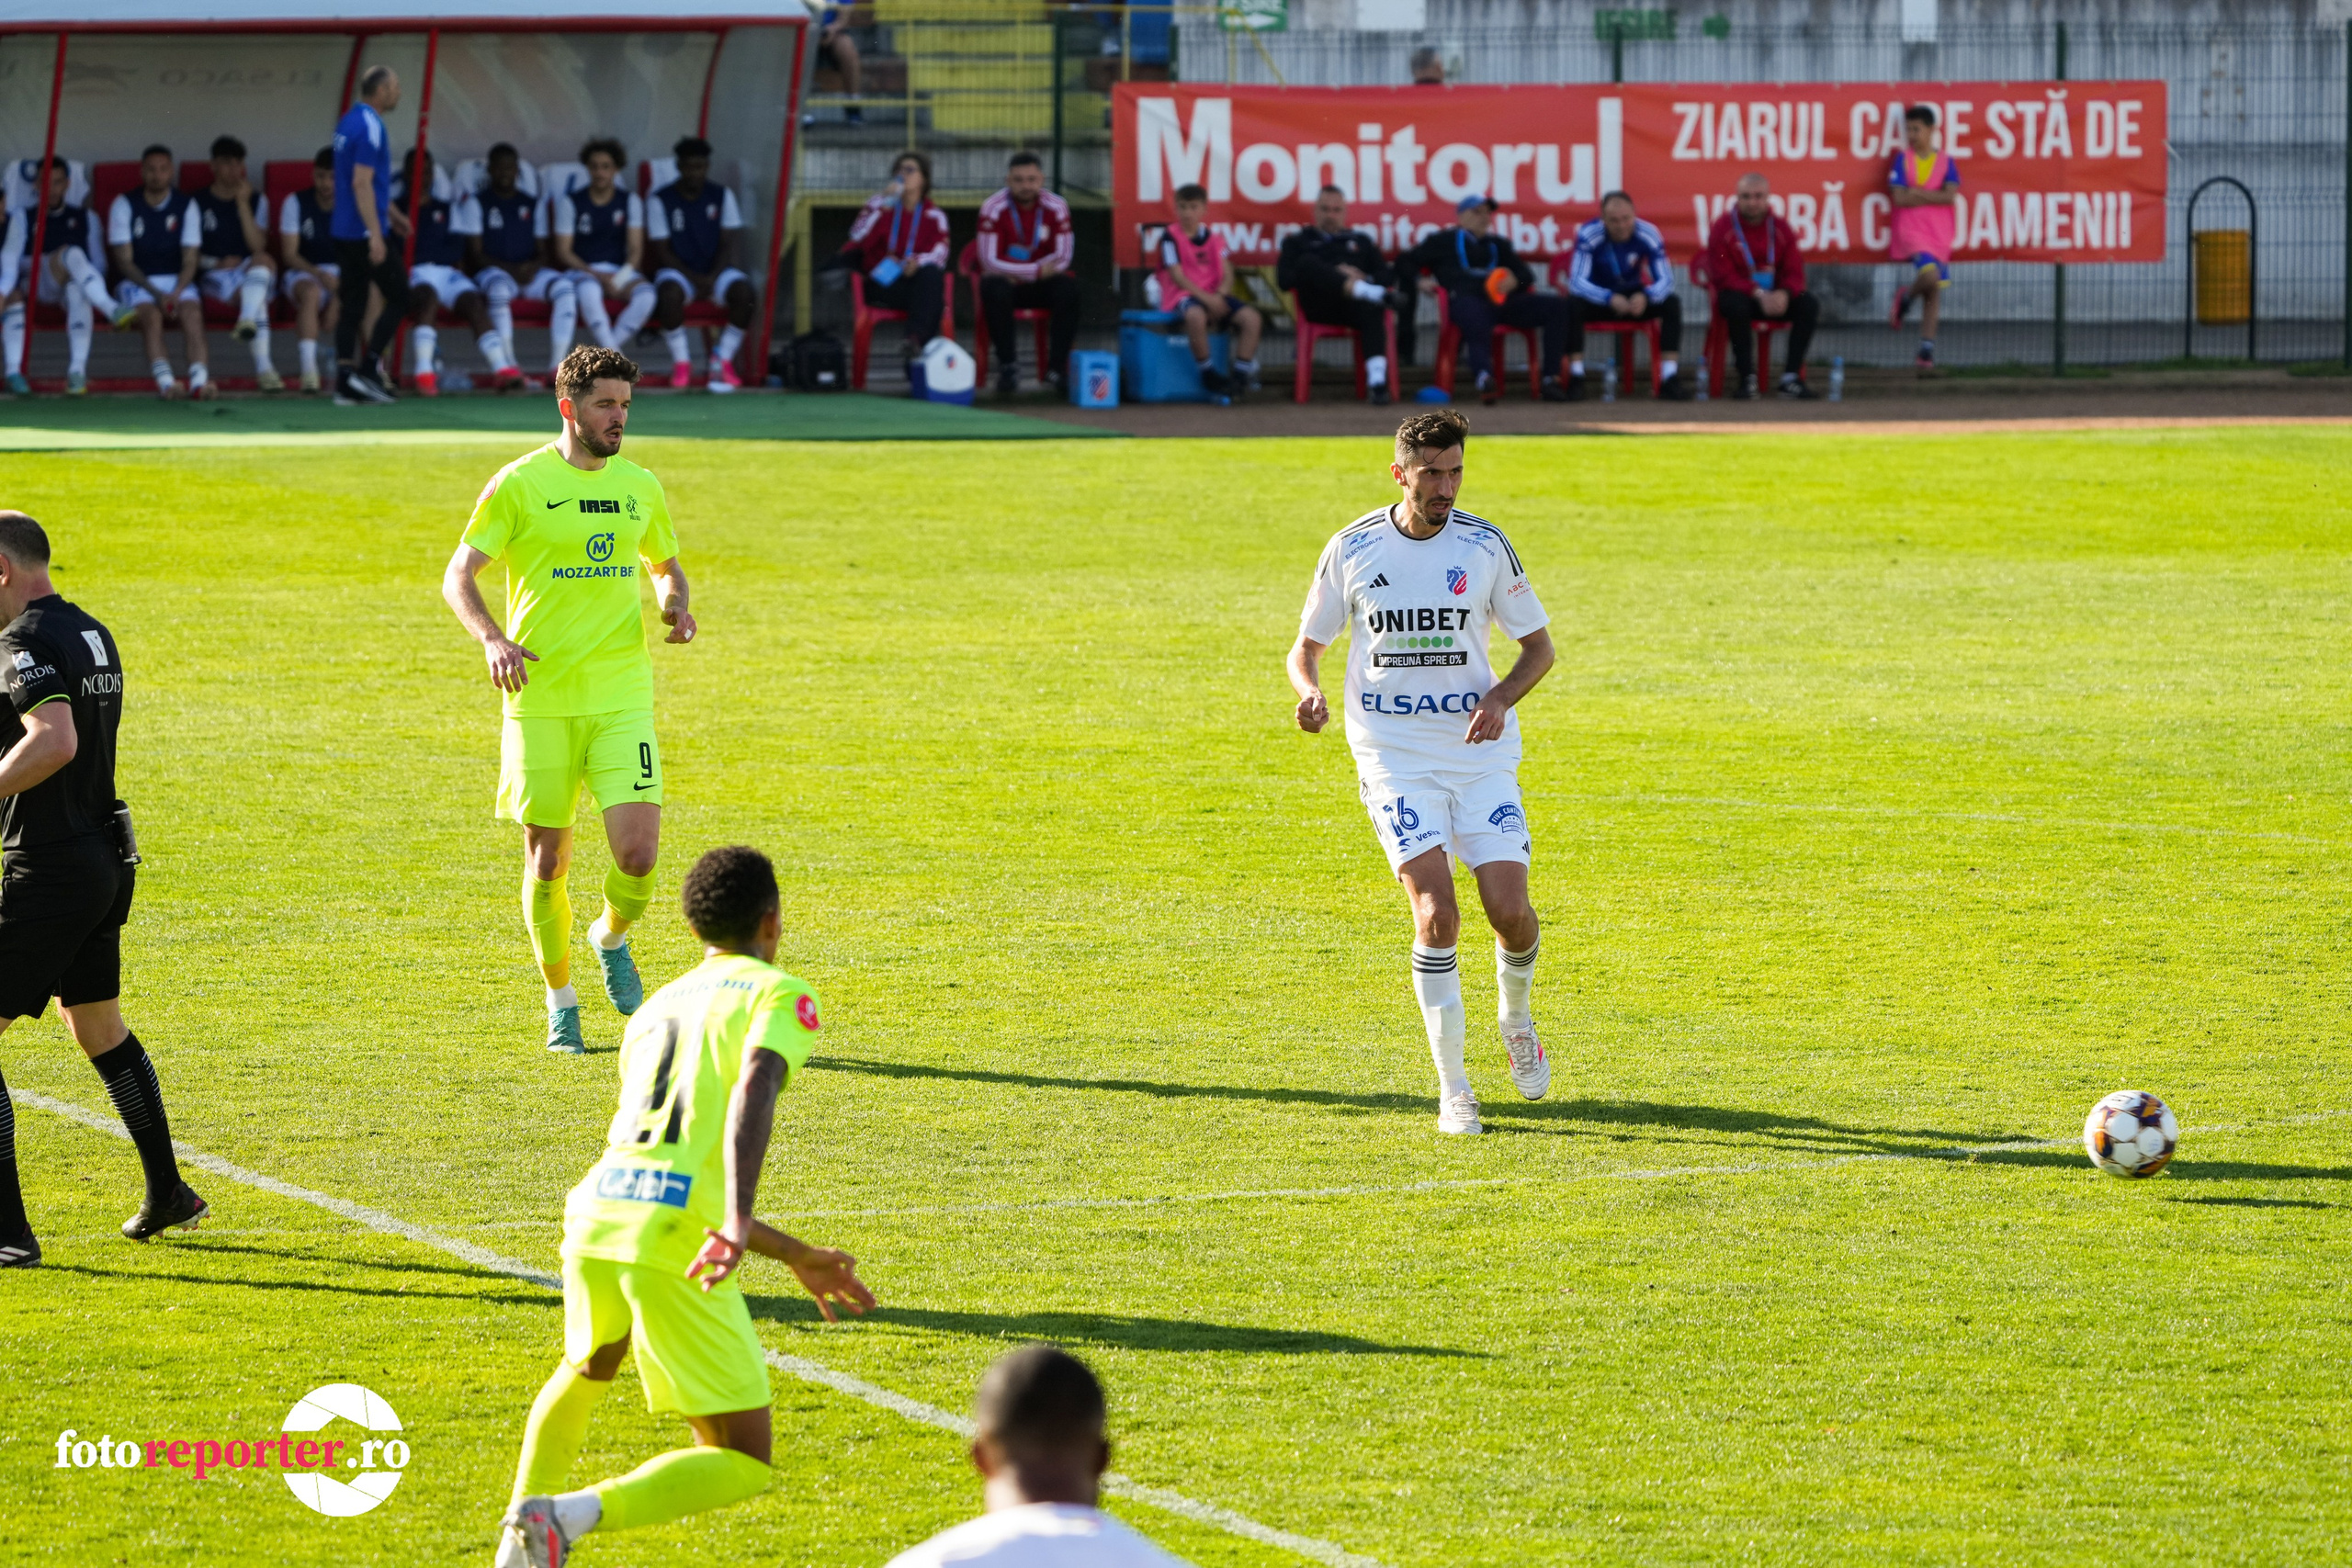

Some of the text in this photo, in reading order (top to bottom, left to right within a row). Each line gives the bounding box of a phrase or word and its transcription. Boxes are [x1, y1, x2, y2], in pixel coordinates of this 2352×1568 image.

[1671, 102, 1838, 160] ZIARUL
[1984, 88, 2073, 159] STĂ
[2086, 99, 2143, 158] DE
[1136, 96, 1623, 205] Monitorul
[1693, 181, 1849, 252] VBĂ
[552, 567, 617, 579] MOZZART
[1368, 608, 1470, 634] UNIBET
[1423, 655, 1447, 665] SPRE
[1449, 654, 1463, 664] 0%
[10, 664, 56, 693] NORDIS
[1361, 692, 1480, 716] ELSACO
[639, 742, 652, 779] 9
[1383, 795, 1419, 838] 16
